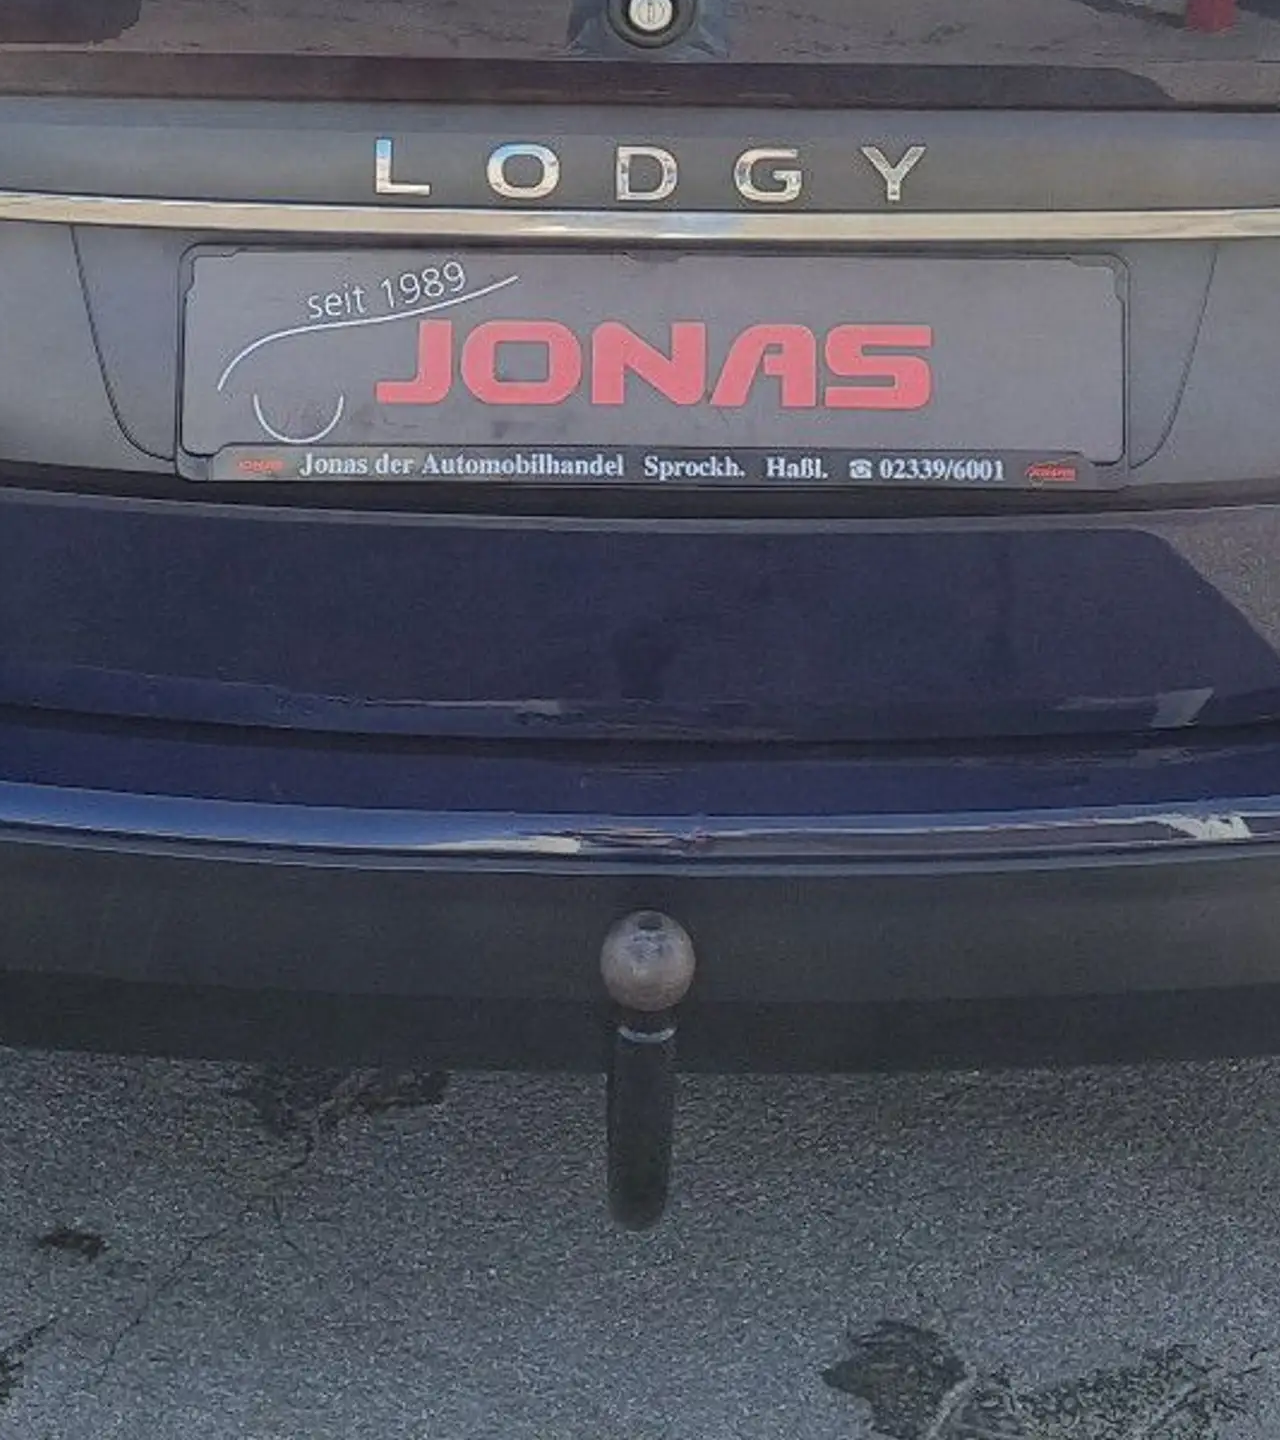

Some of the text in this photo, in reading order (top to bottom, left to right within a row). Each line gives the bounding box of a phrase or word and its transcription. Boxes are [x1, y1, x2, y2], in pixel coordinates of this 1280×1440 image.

[373, 137, 927, 204] LODGY
[308, 260, 467, 319] seit 1989
[375, 318, 933, 410] JONAS
[298, 452, 368, 477] Jonas
[373, 452, 414, 477] der
[420, 452, 624, 479] Automobilhandel
[643, 455, 746, 481] Sprockh.
[878, 457, 1005, 483] 02339/6001
